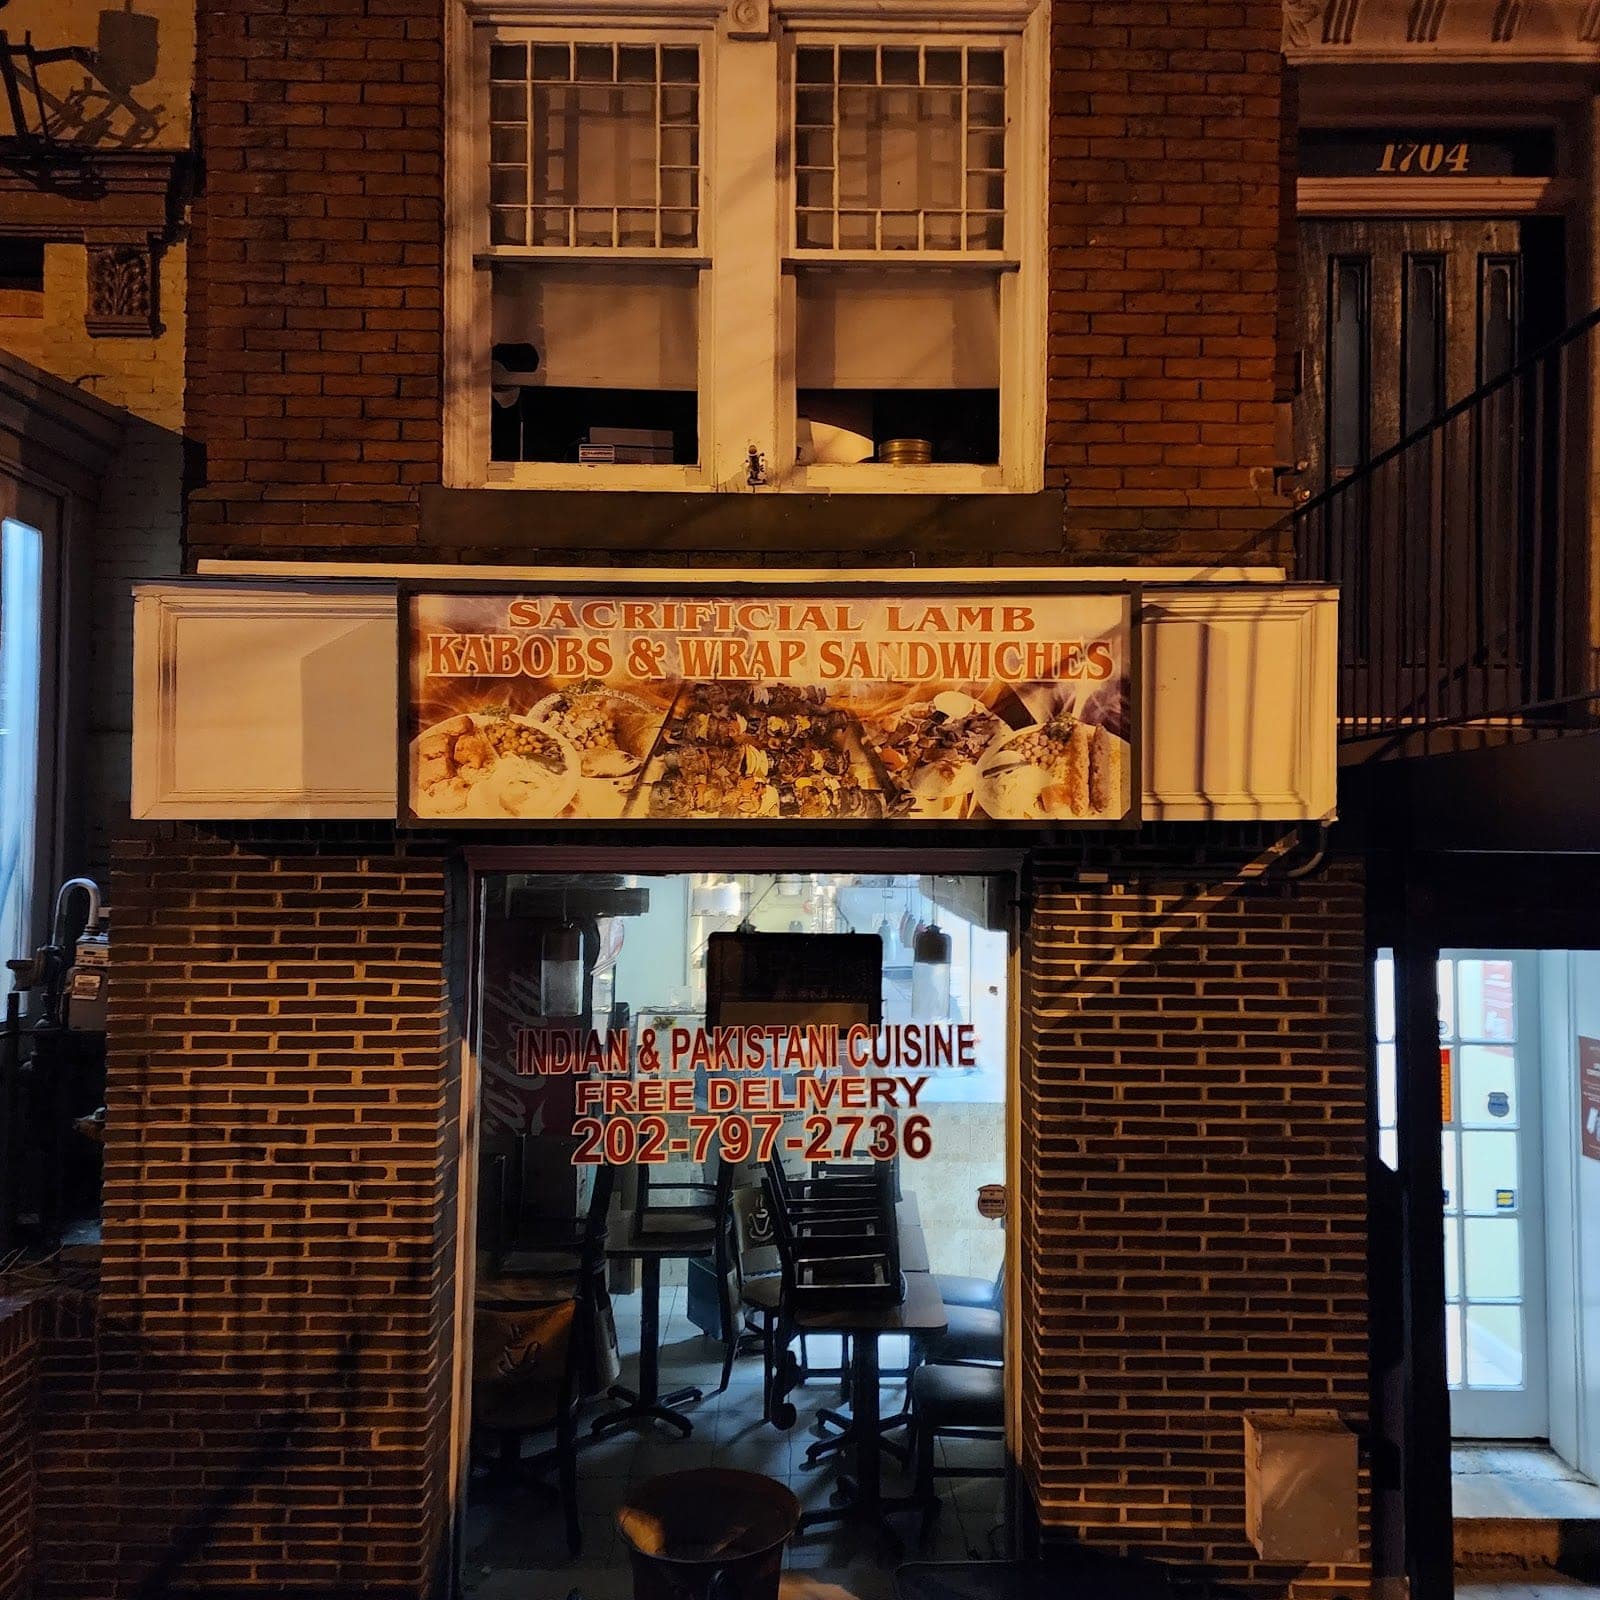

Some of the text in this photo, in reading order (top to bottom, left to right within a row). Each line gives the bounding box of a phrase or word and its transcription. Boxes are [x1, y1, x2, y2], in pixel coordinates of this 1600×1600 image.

[1376, 143, 1469, 172] 1704
[508, 600, 1037, 633] SACRIFICIAL LAMB
[427, 634, 1114, 682] KABOBS & WRAP SANDWICHES
[516, 1022, 977, 1076] INDIAN & PAKISTANI CUISINE
[575, 1075, 931, 1116] FREE DELIVERY
[571, 1114, 933, 1166] 202-797-2736
